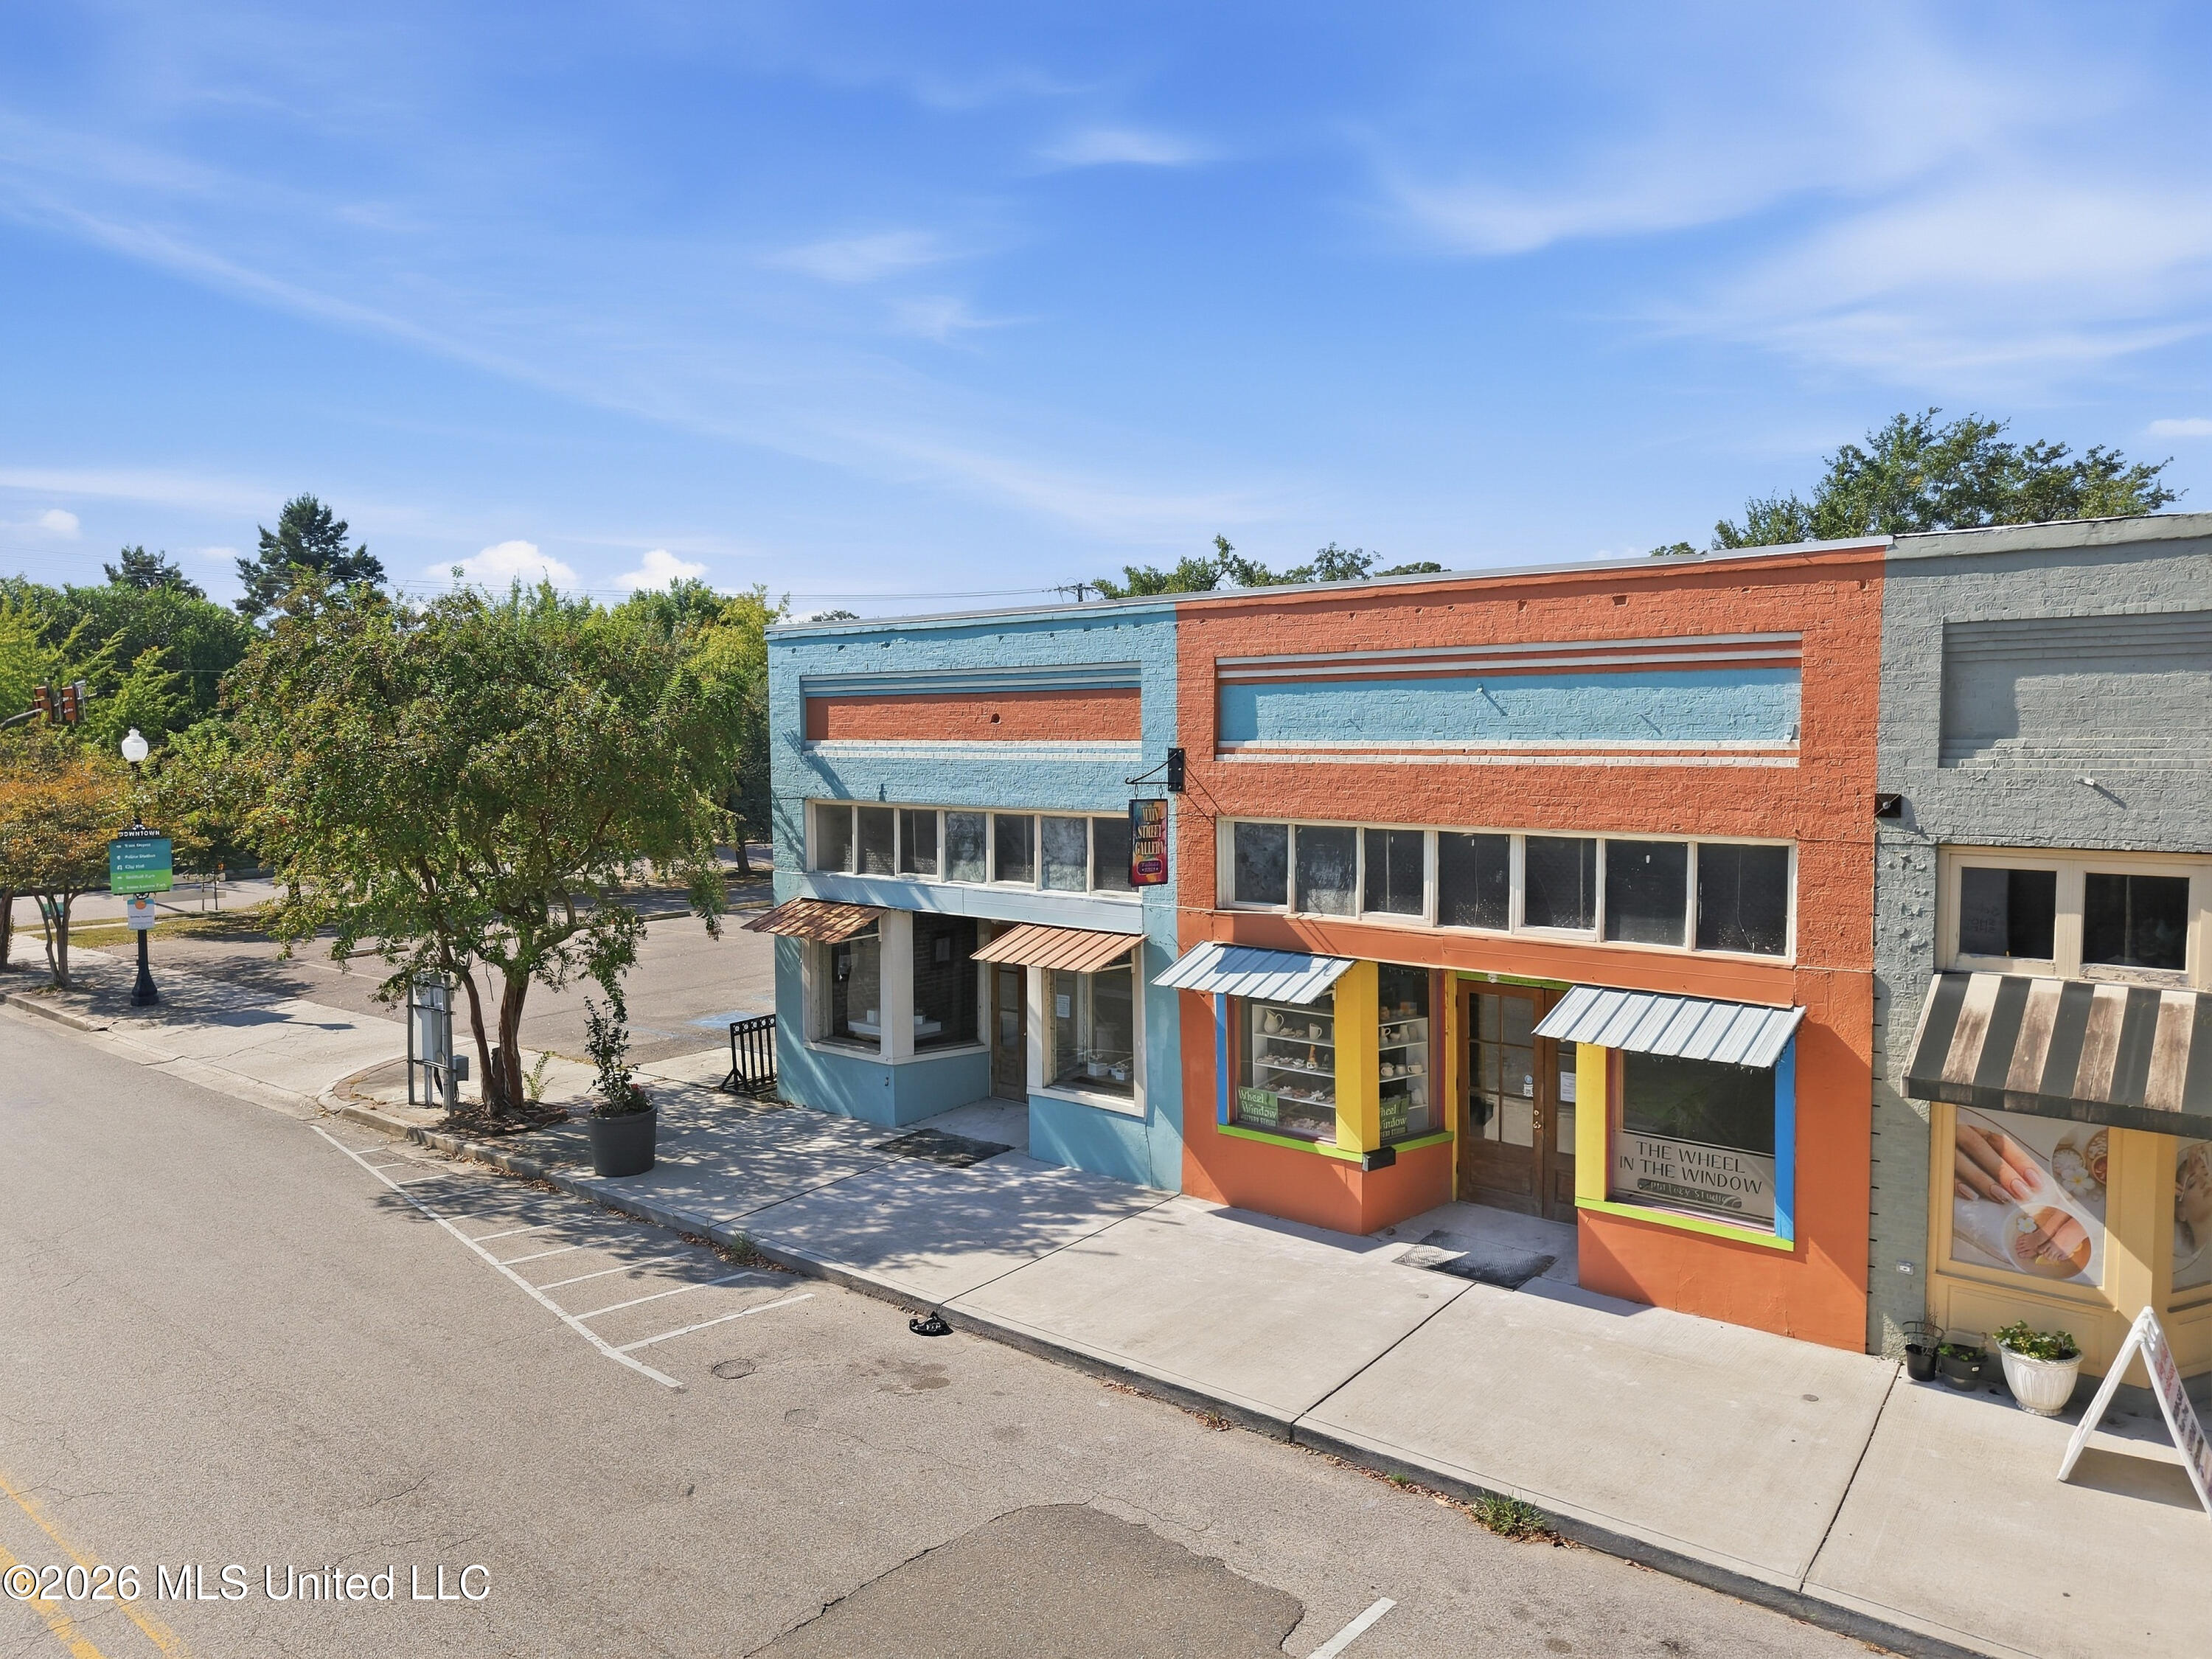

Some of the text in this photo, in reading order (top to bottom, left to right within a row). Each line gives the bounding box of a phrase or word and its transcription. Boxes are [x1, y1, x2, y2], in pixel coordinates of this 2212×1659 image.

[1138, 824, 1161, 839] STREET
[1135, 841, 1164, 855] GALLERY
[1239, 1089, 1264, 1104] Wheel
[1242, 1101, 1277, 1118] Window
[1380, 1104, 1397, 1116] heel
[1381, 1116, 1407, 1129] indow
[1636, 1141, 1746, 1174] THE WHEEL
[1619, 1155, 1762, 1194] IN THE WINDOW
